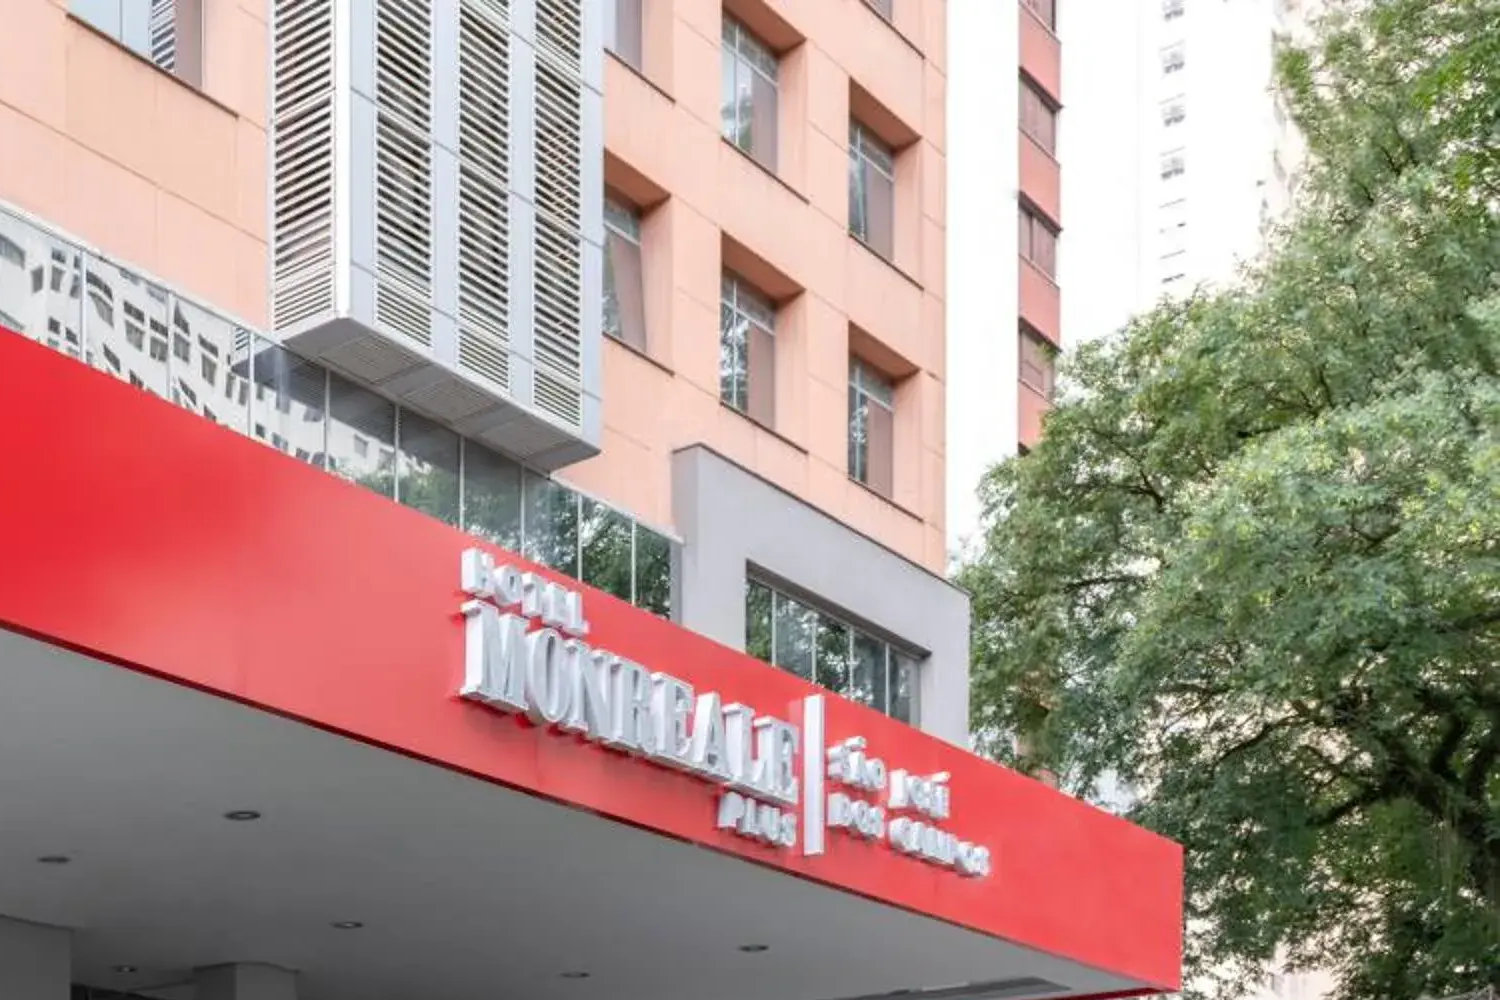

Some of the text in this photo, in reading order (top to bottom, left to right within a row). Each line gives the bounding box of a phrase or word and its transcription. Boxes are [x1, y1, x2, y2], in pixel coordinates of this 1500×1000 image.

[461, 548, 589, 635] HOTEL
[460, 599, 798, 805] MONREALE
[717, 791, 797, 848] PLUS
